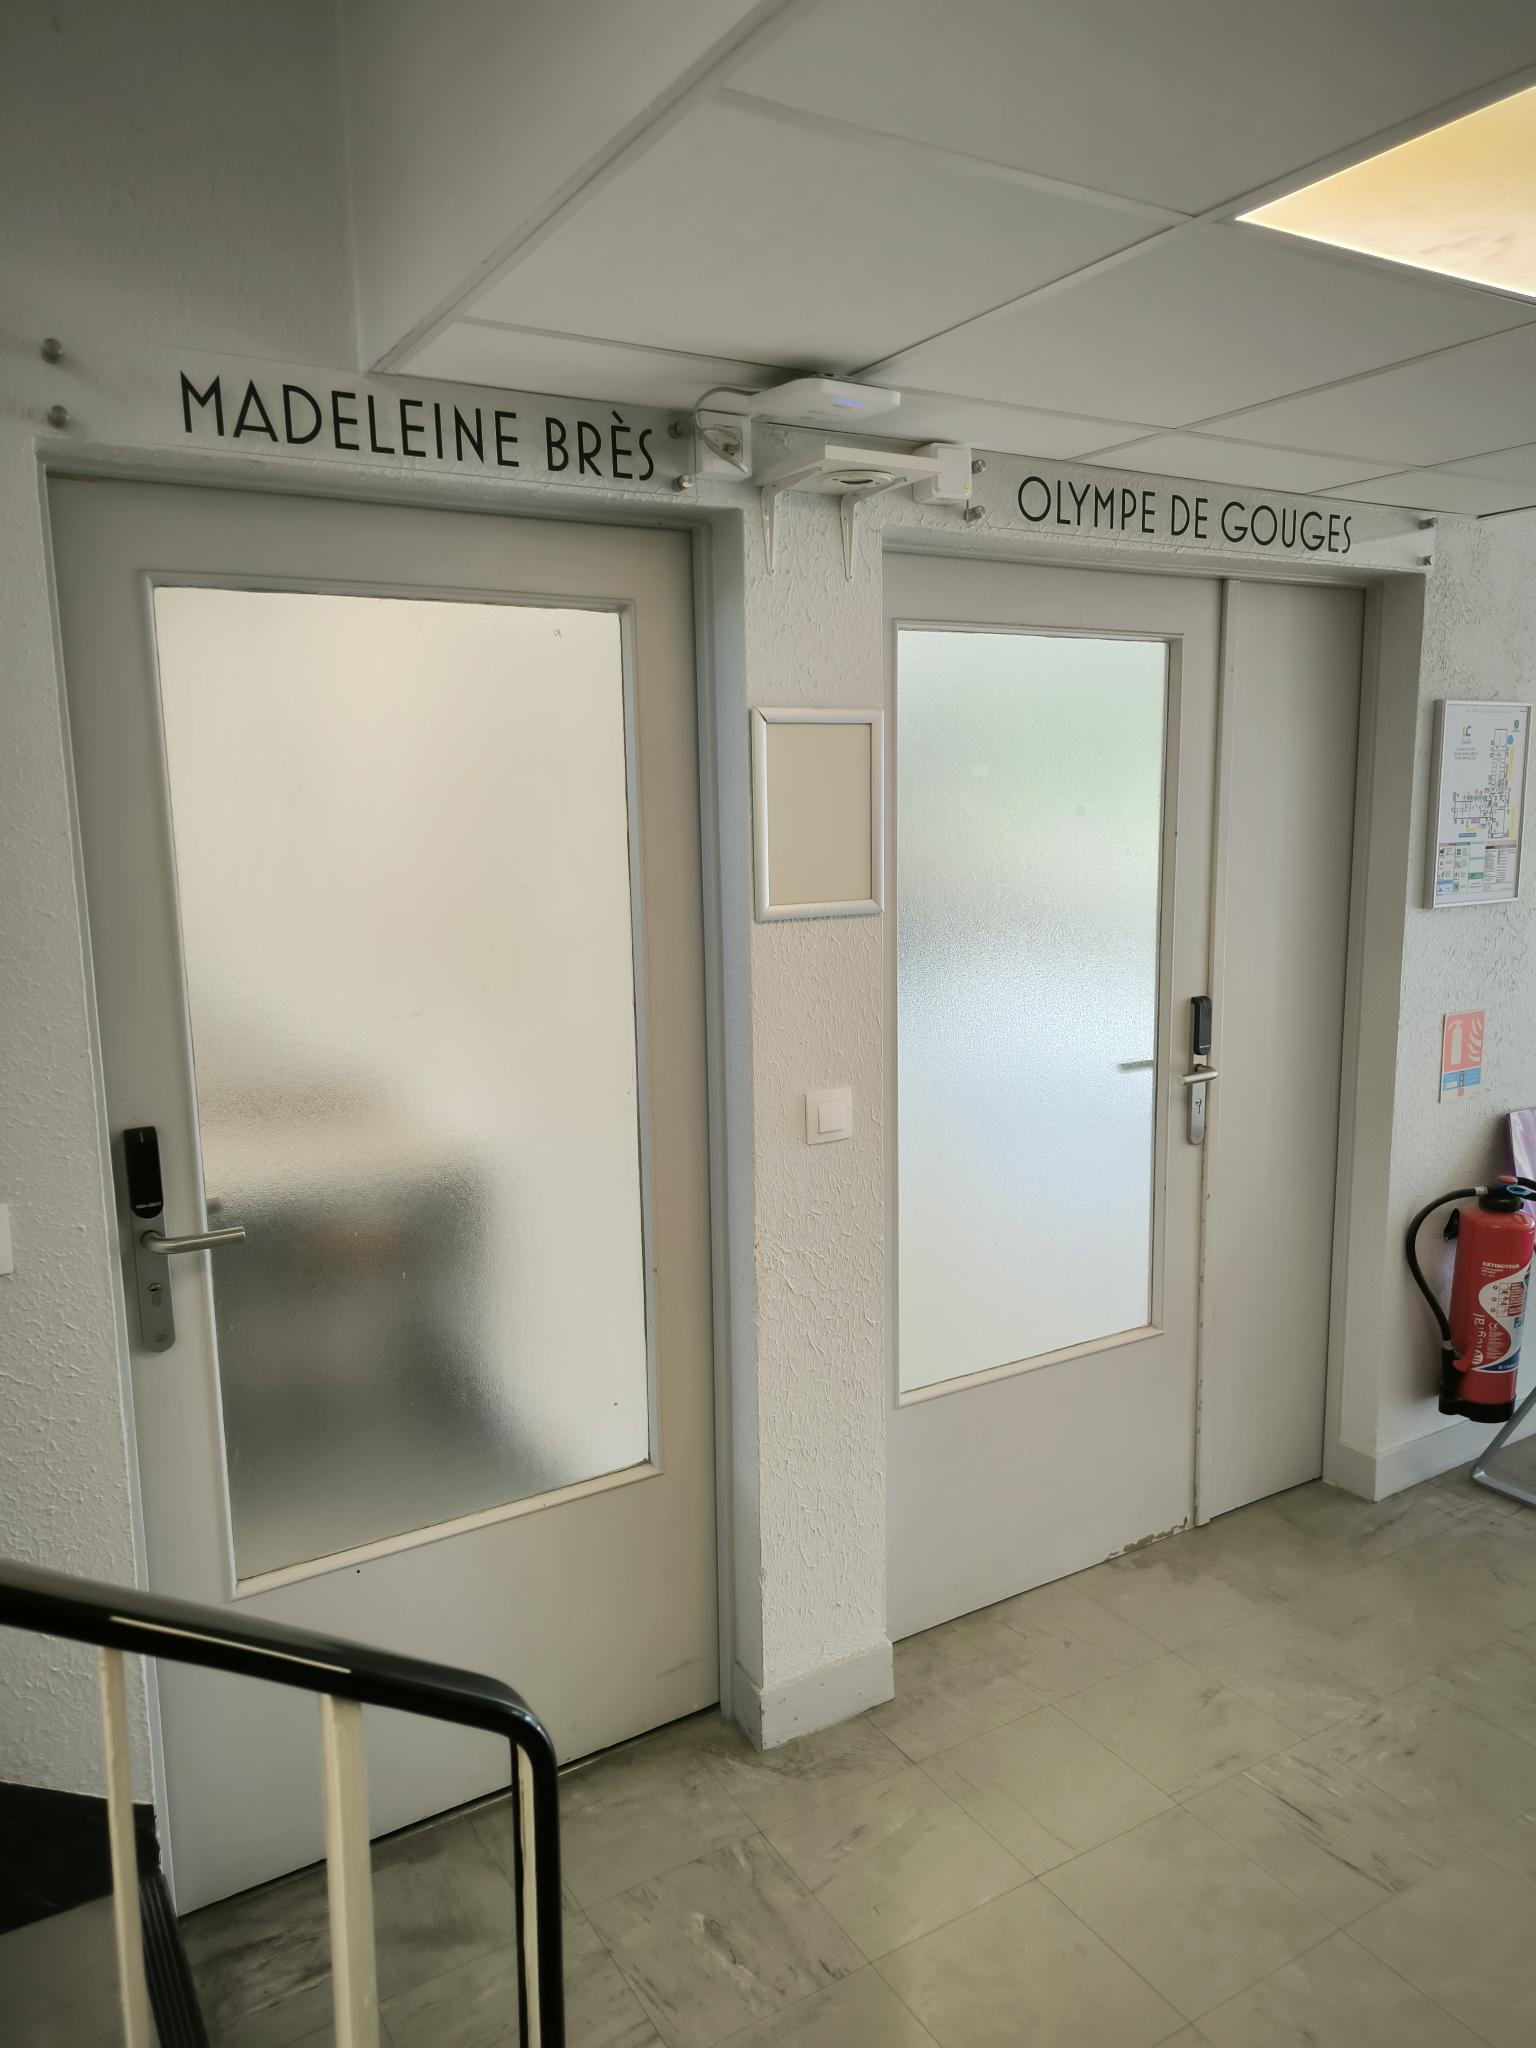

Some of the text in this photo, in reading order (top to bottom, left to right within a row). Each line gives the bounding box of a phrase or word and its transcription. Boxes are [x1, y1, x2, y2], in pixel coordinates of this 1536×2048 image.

[181, 371, 655, 482] MADELEINE BRÈS
[1018, 475, 1353, 554] OLYMPE DE GOUGES
